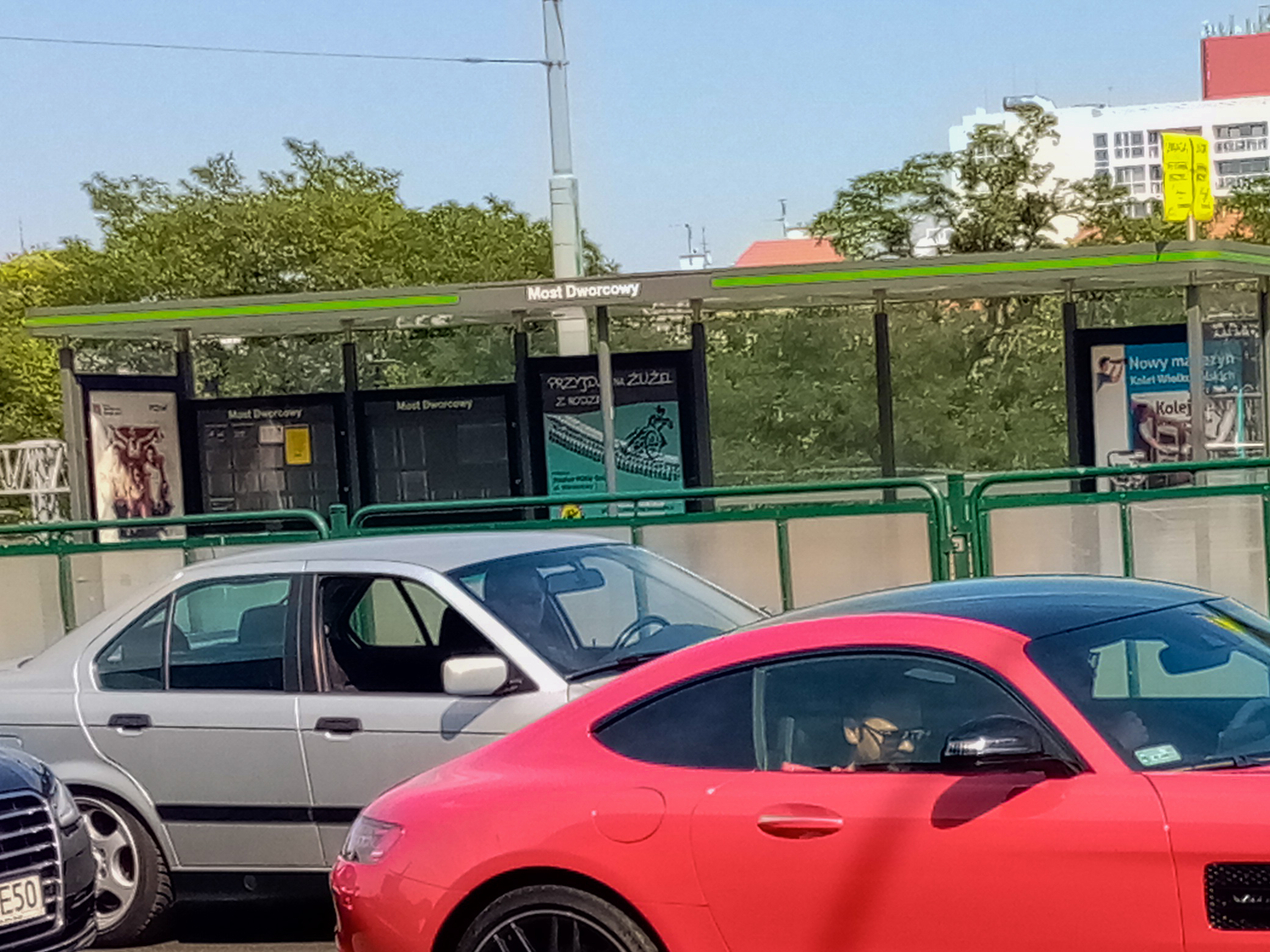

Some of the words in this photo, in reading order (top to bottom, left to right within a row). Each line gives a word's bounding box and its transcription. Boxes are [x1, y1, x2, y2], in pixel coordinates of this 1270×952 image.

[527, 285, 563, 300] Most
[566, 283, 641, 299] Dworcowy
[1129, 355, 1168, 372] Nowy
[396, 399, 421, 411] Most
[1155, 400, 1192, 417] Kolej
[227, 409, 252, 419] Most
